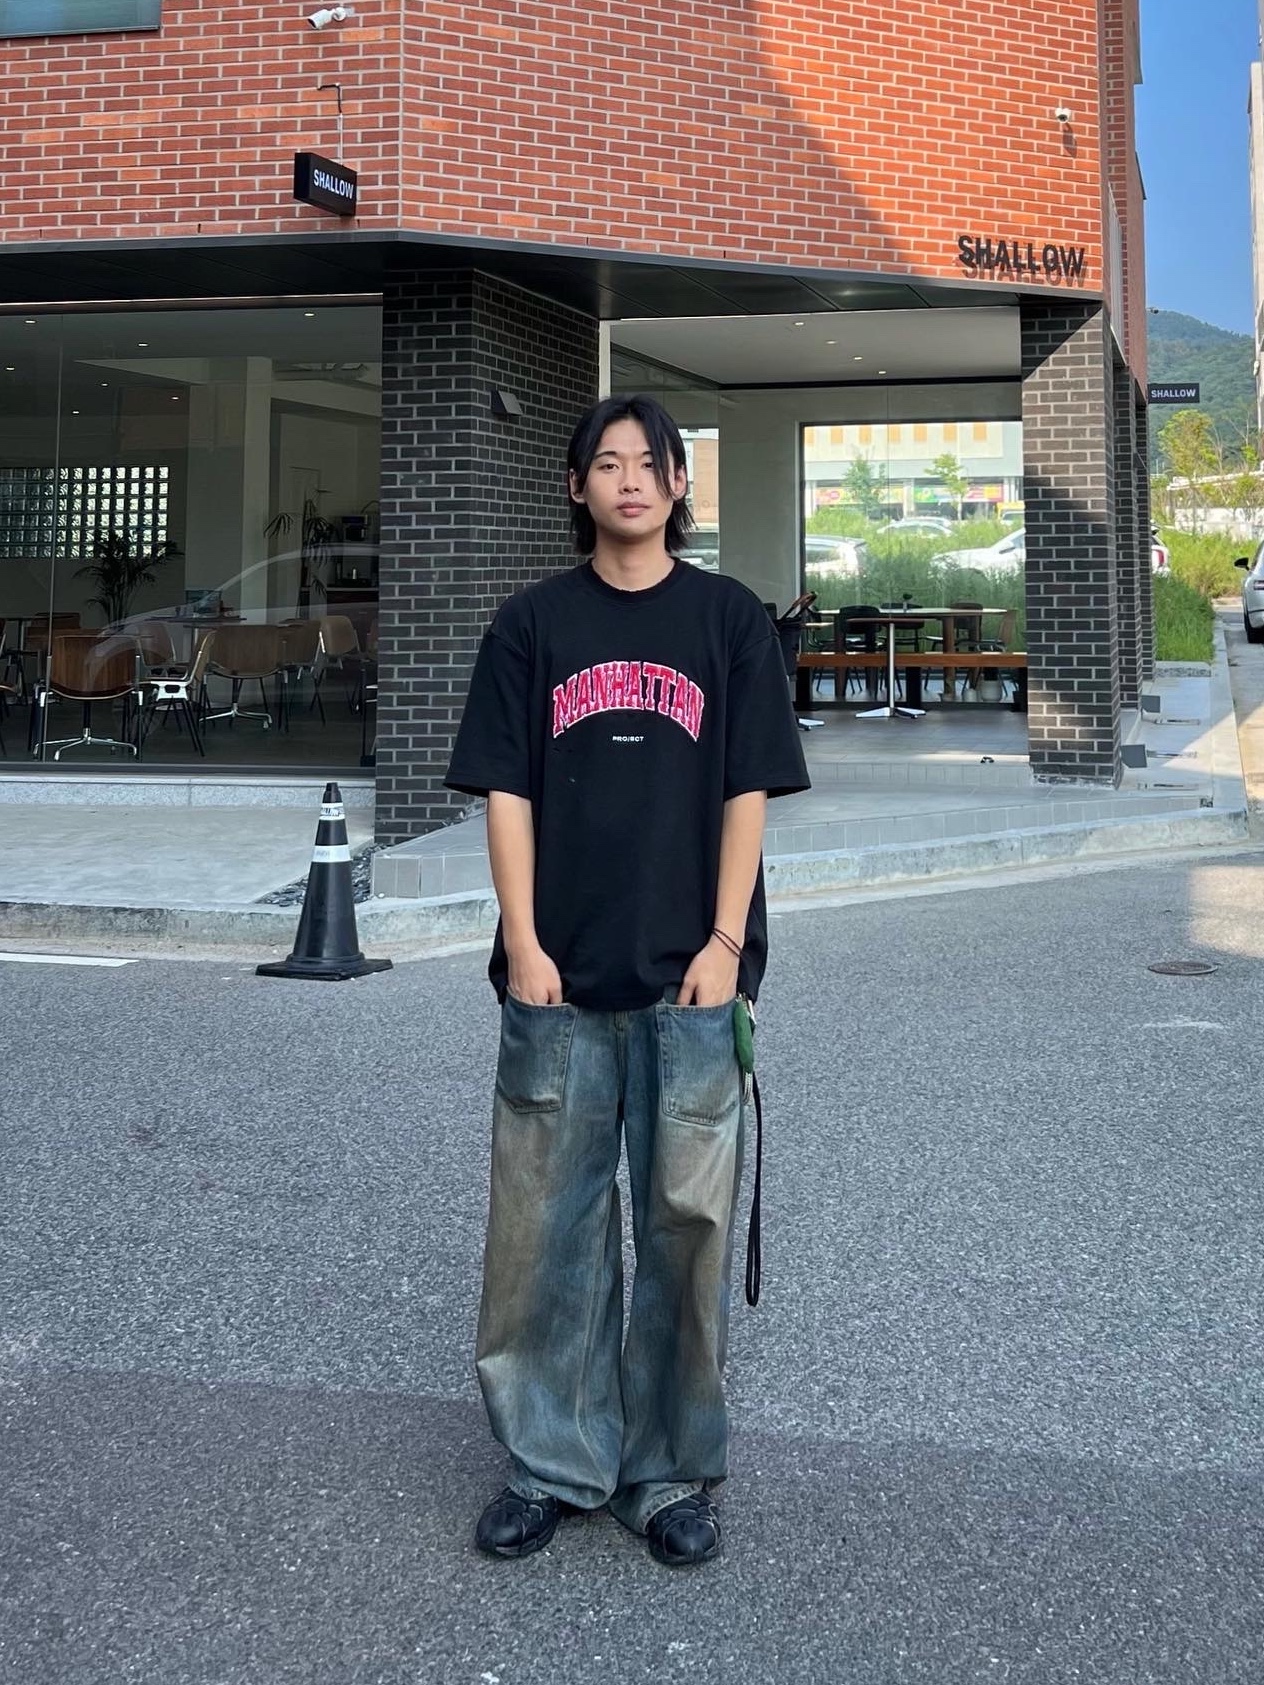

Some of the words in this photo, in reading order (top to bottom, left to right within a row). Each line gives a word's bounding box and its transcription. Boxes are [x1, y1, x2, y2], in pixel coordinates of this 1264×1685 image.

[313, 168, 354, 200] SHALLOW
[958, 234, 1086, 278] SHALLOW
[1150, 388, 1197, 398] SHALLOW
[553, 660, 705, 742] MANHATTAN
